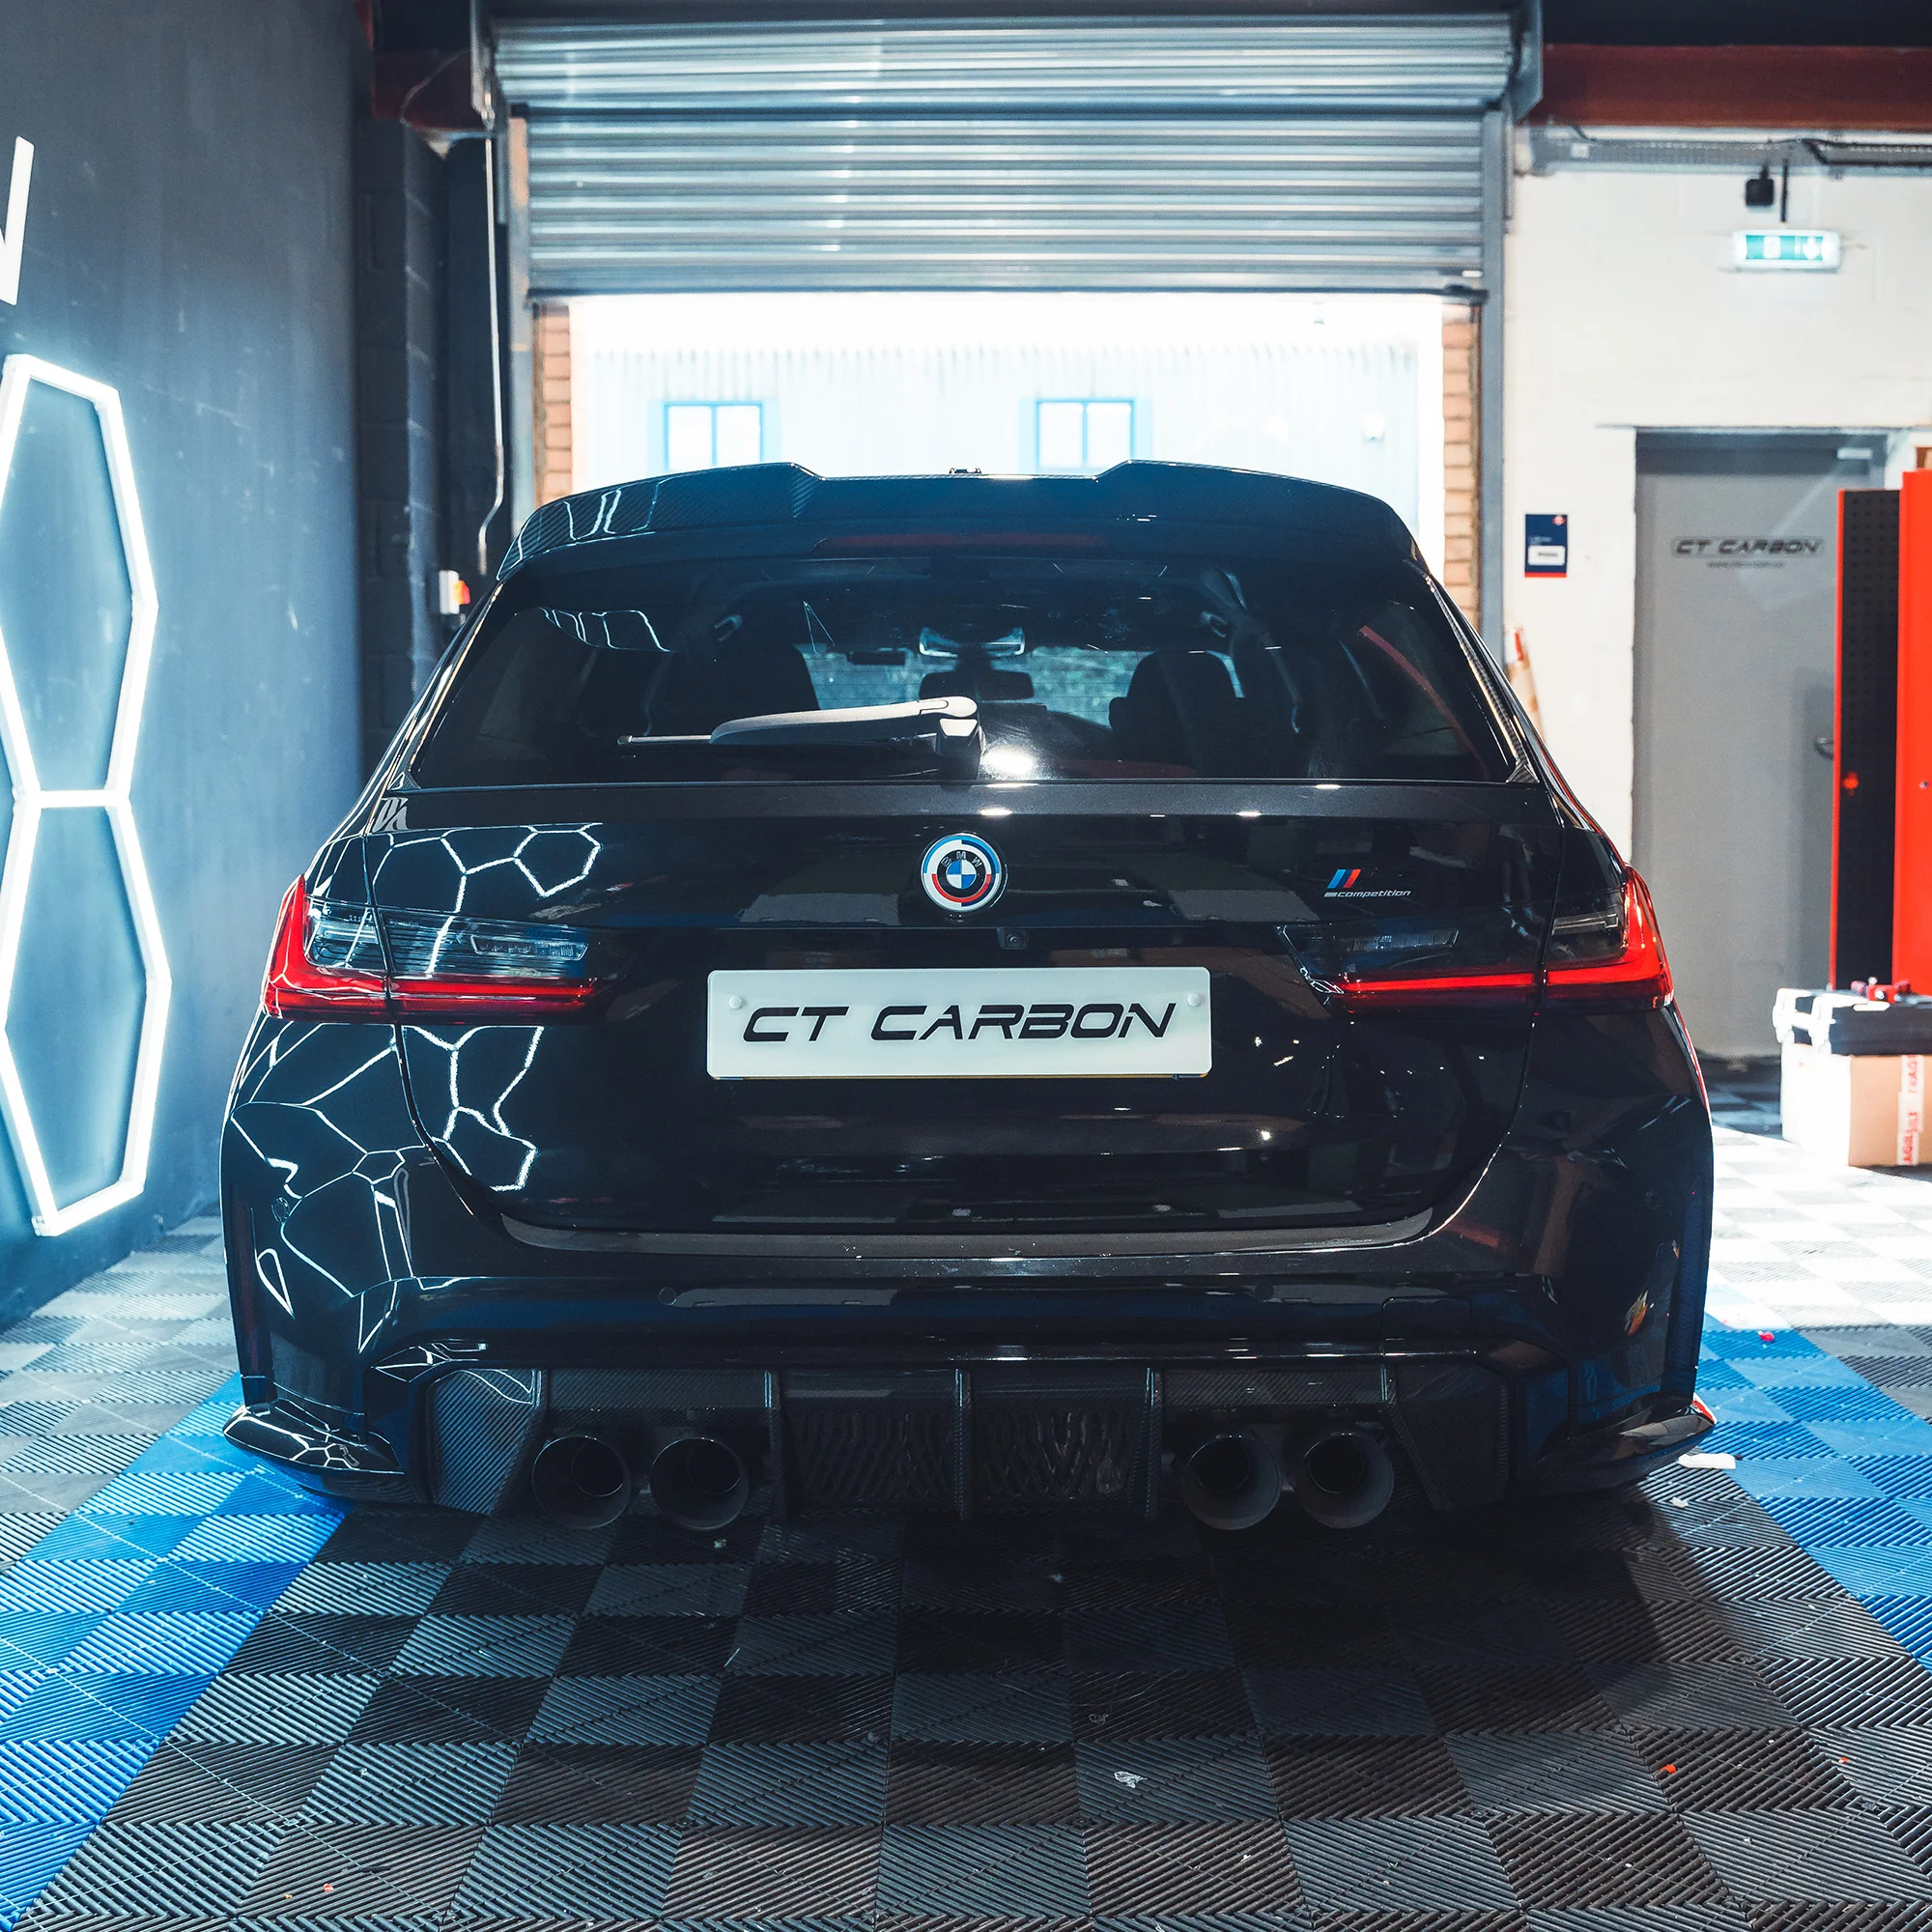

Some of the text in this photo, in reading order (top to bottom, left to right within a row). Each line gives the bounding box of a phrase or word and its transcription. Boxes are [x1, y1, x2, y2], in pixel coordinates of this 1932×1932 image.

[1676, 538, 1824, 554] CT CARBON
[940, 850, 983, 868] BMW
[1336, 889, 1411, 898] competition
[743, 1002, 1177, 1042] CT CARBON
